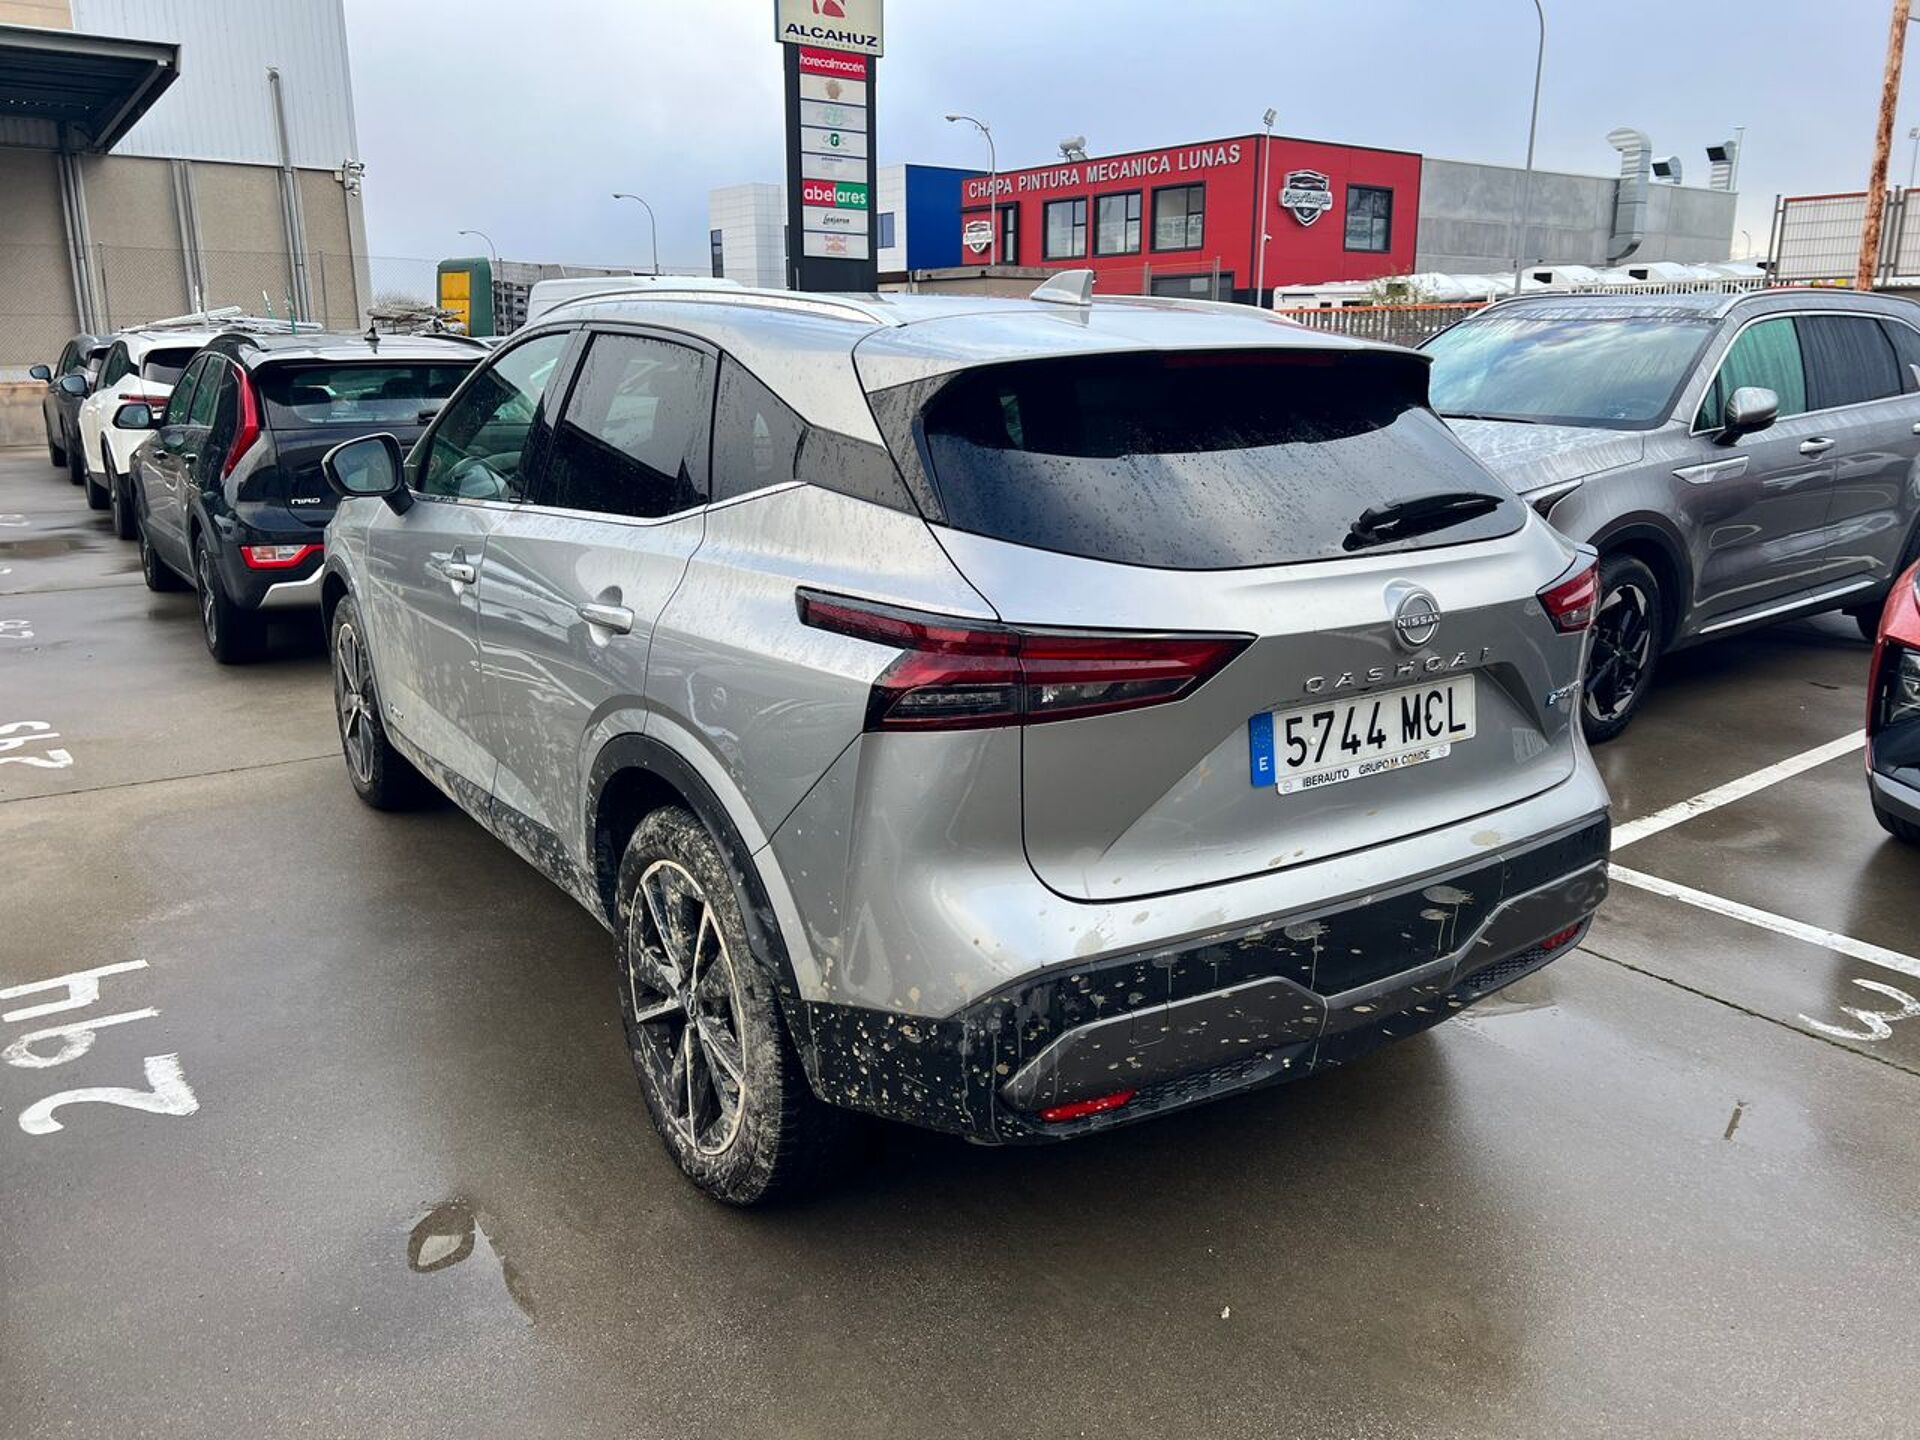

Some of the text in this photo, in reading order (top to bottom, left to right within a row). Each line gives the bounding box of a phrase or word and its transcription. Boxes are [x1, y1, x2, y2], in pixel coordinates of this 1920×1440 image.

[785, 23, 878, 47] ALCAHUZ
[968, 143, 1241, 199] CHAPA PINTURA MECANICA LUNAS
[804, 185, 866, 205] abelares
[1397, 613, 1441, 628] NISSAN
[1285, 687, 1466, 768] 5744 MCL
[1258, 757, 1269, 772] E
[1302, 769, 1350, 789] IBERAUTO
[1358, 761, 1389, 776] GRUPO
